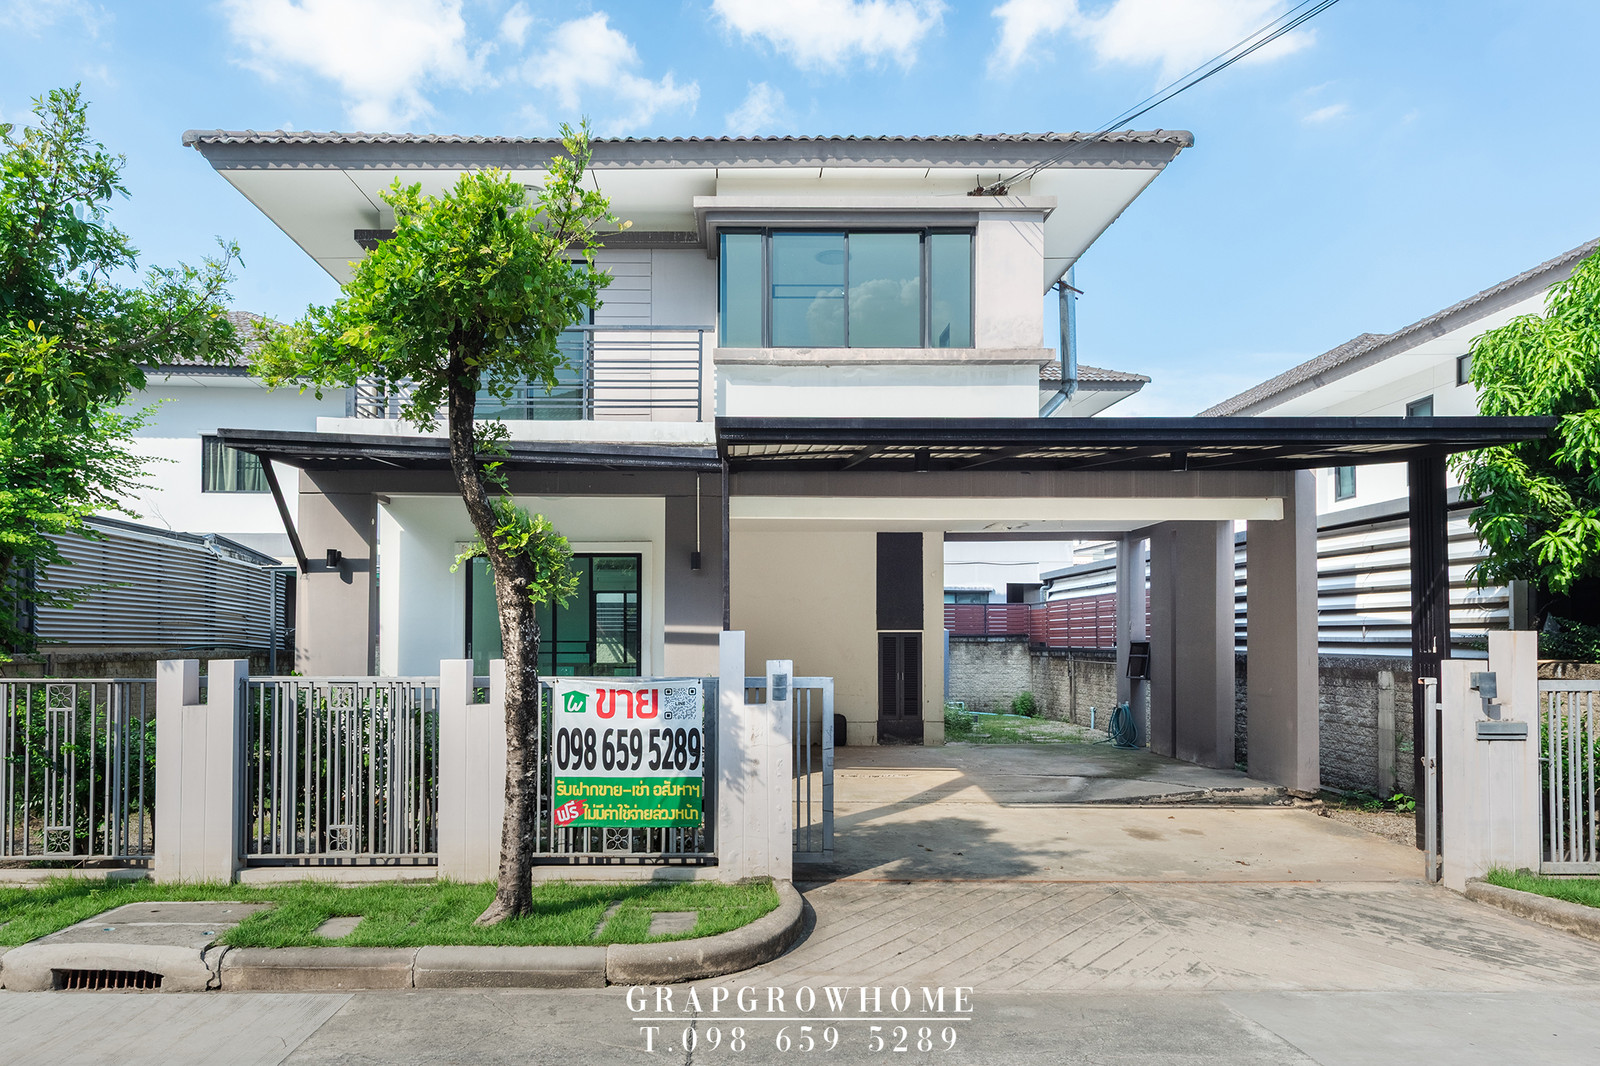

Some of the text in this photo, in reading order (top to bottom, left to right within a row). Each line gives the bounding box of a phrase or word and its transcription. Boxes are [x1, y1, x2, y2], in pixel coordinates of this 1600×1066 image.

[596, 688, 659, 719] ขาย
[556, 727, 701, 771] 098 659 5289
[556, 801, 579, 823] ฟรี
[582, 803, 699, 820] ไม่มีค่าใช้จ่ายล่วงหน้า
